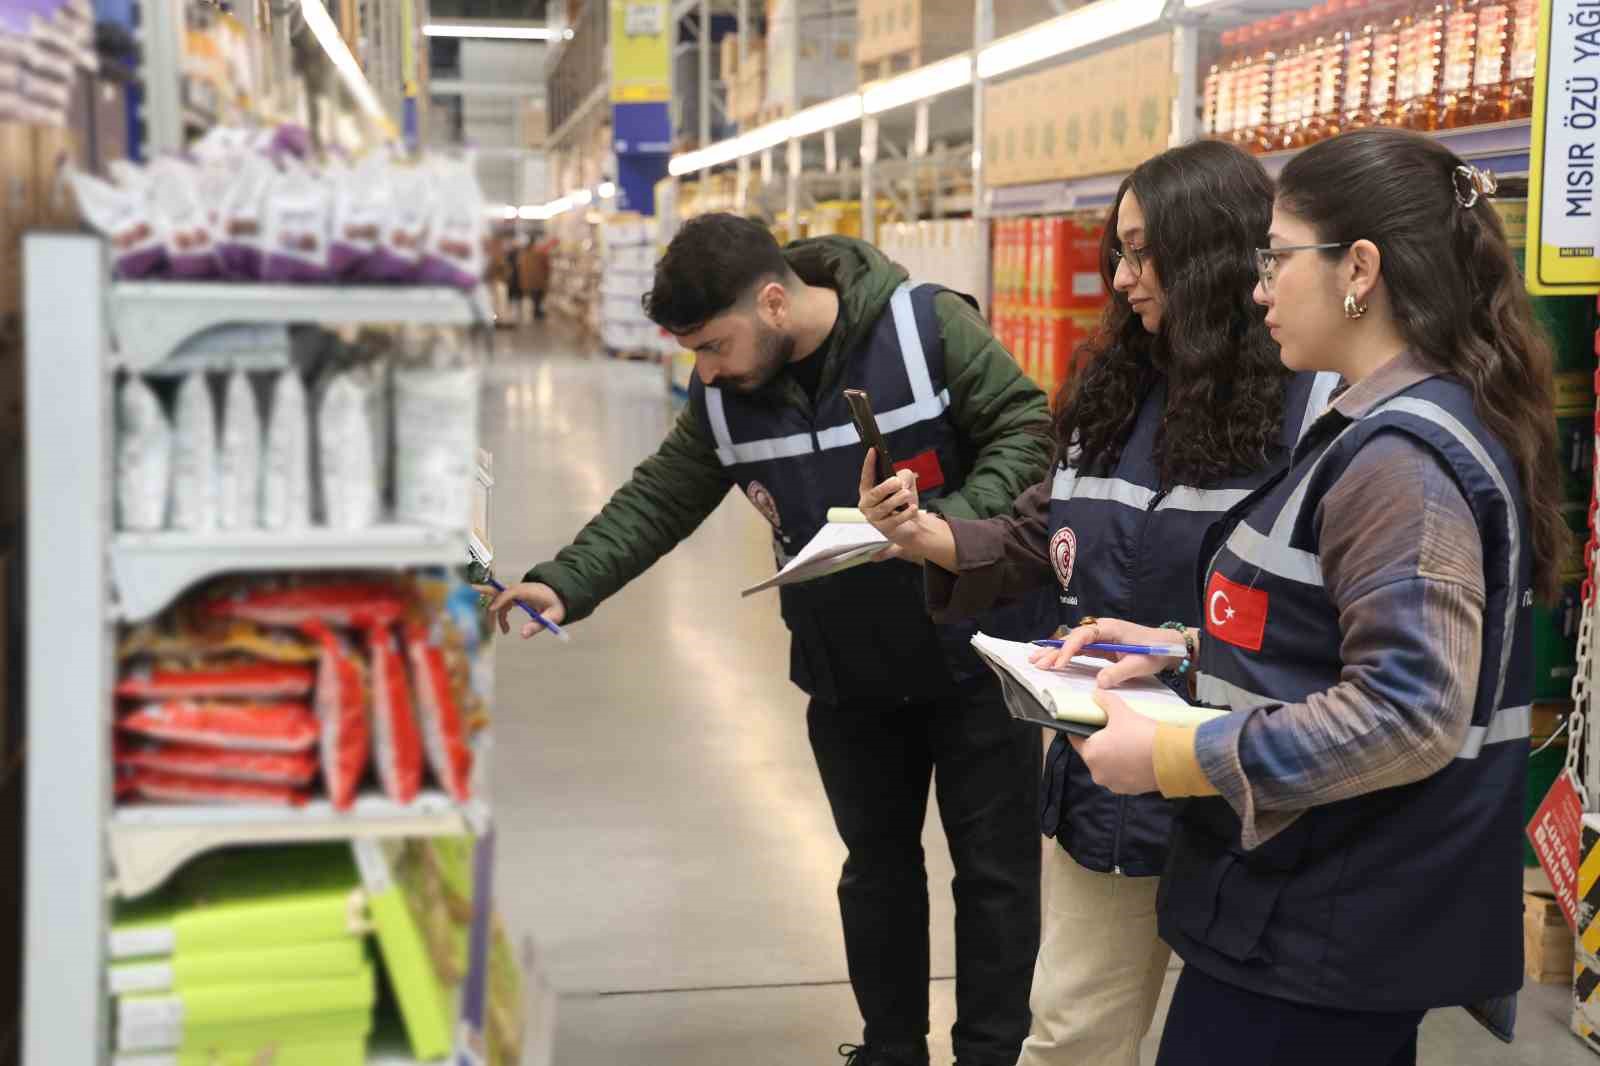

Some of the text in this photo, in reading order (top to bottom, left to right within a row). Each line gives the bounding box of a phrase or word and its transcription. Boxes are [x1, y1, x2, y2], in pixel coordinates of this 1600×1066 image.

[1563, 76, 1599, 130] ÖZÜ
[1565, 142, 1596, 217] MISIR
[1561, 247, 1593, 256] METRO
